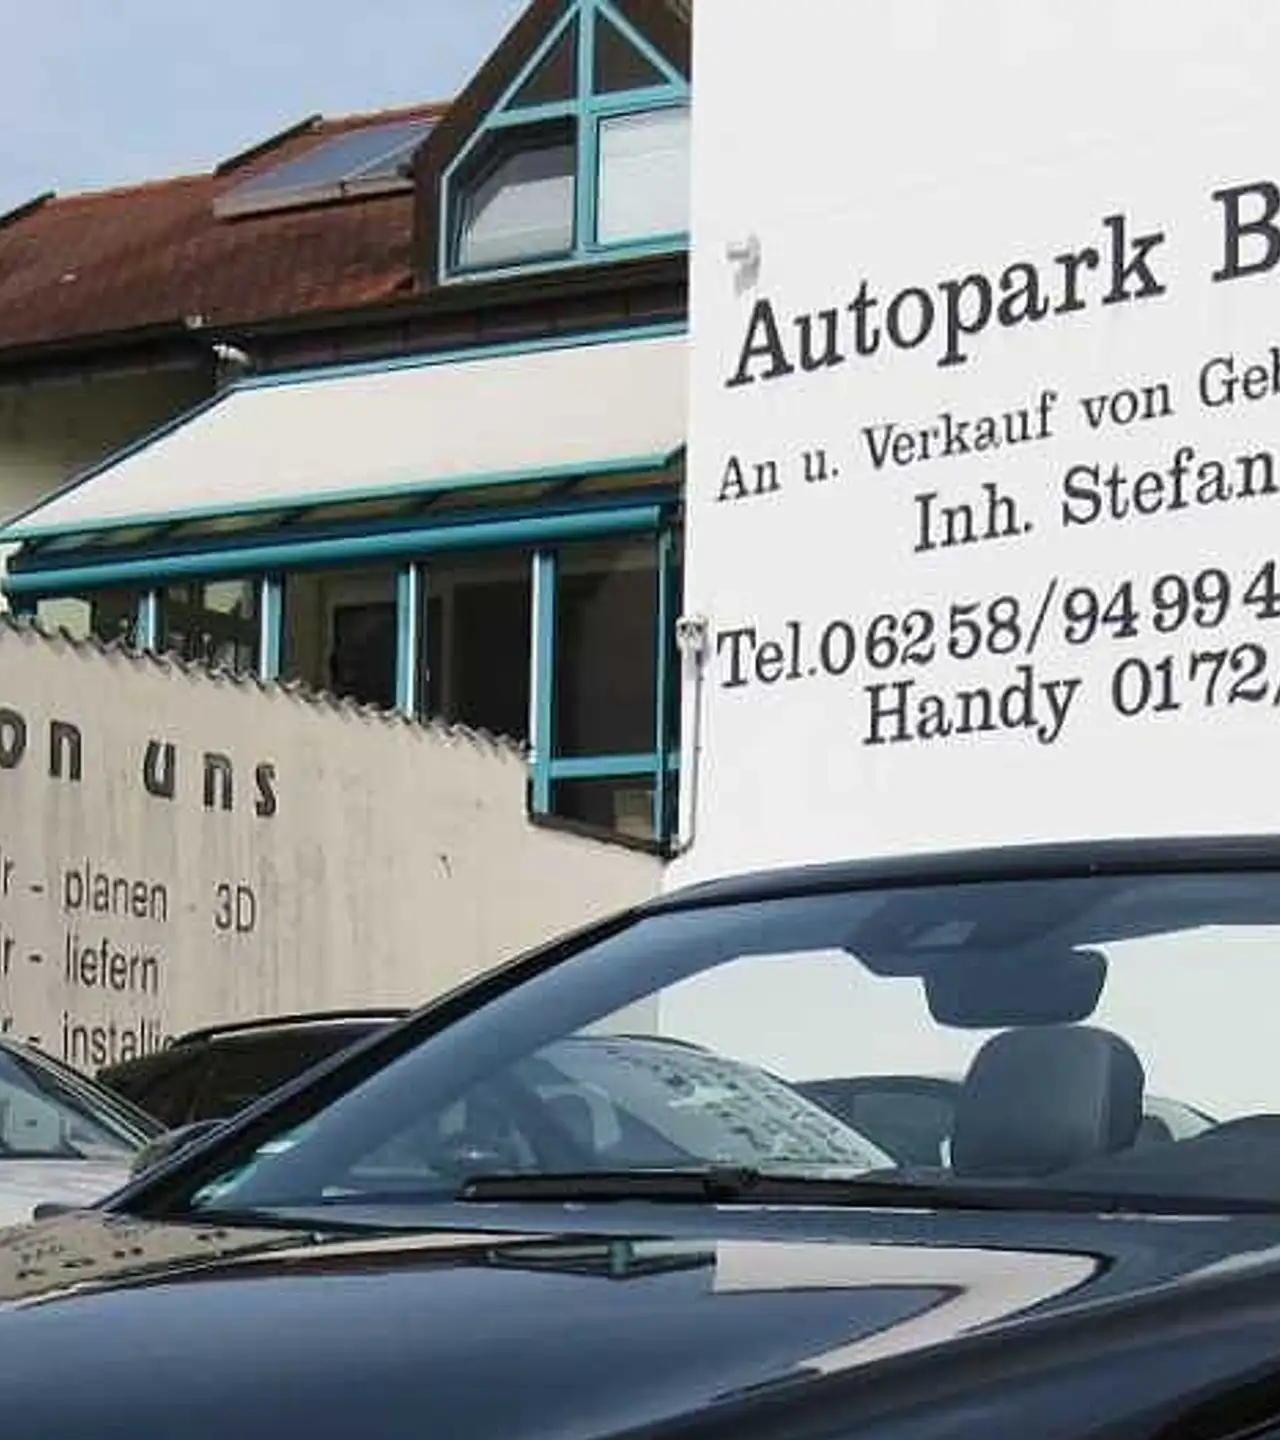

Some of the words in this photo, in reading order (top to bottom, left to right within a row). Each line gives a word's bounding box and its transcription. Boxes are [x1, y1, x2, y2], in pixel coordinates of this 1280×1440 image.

[726, 215, 1165, 387] Autopark
[717, 456, 780, 503] An
[803, 450, 839, 483] u.
[862, 390, 1058, 470] Verkauf
[1080, 383, 1173, 430] von
[915, 483, 1033, 552] Inh.
[1063, 447, 1280, 527] Stefan
[864, 664, 1082, 745] Handy
[143, 740, 277, 818] uns
[65, 857, 168, 922] planen
[215, 883, 255, 933] 3D
[66, 931, 158, 993] liefern
